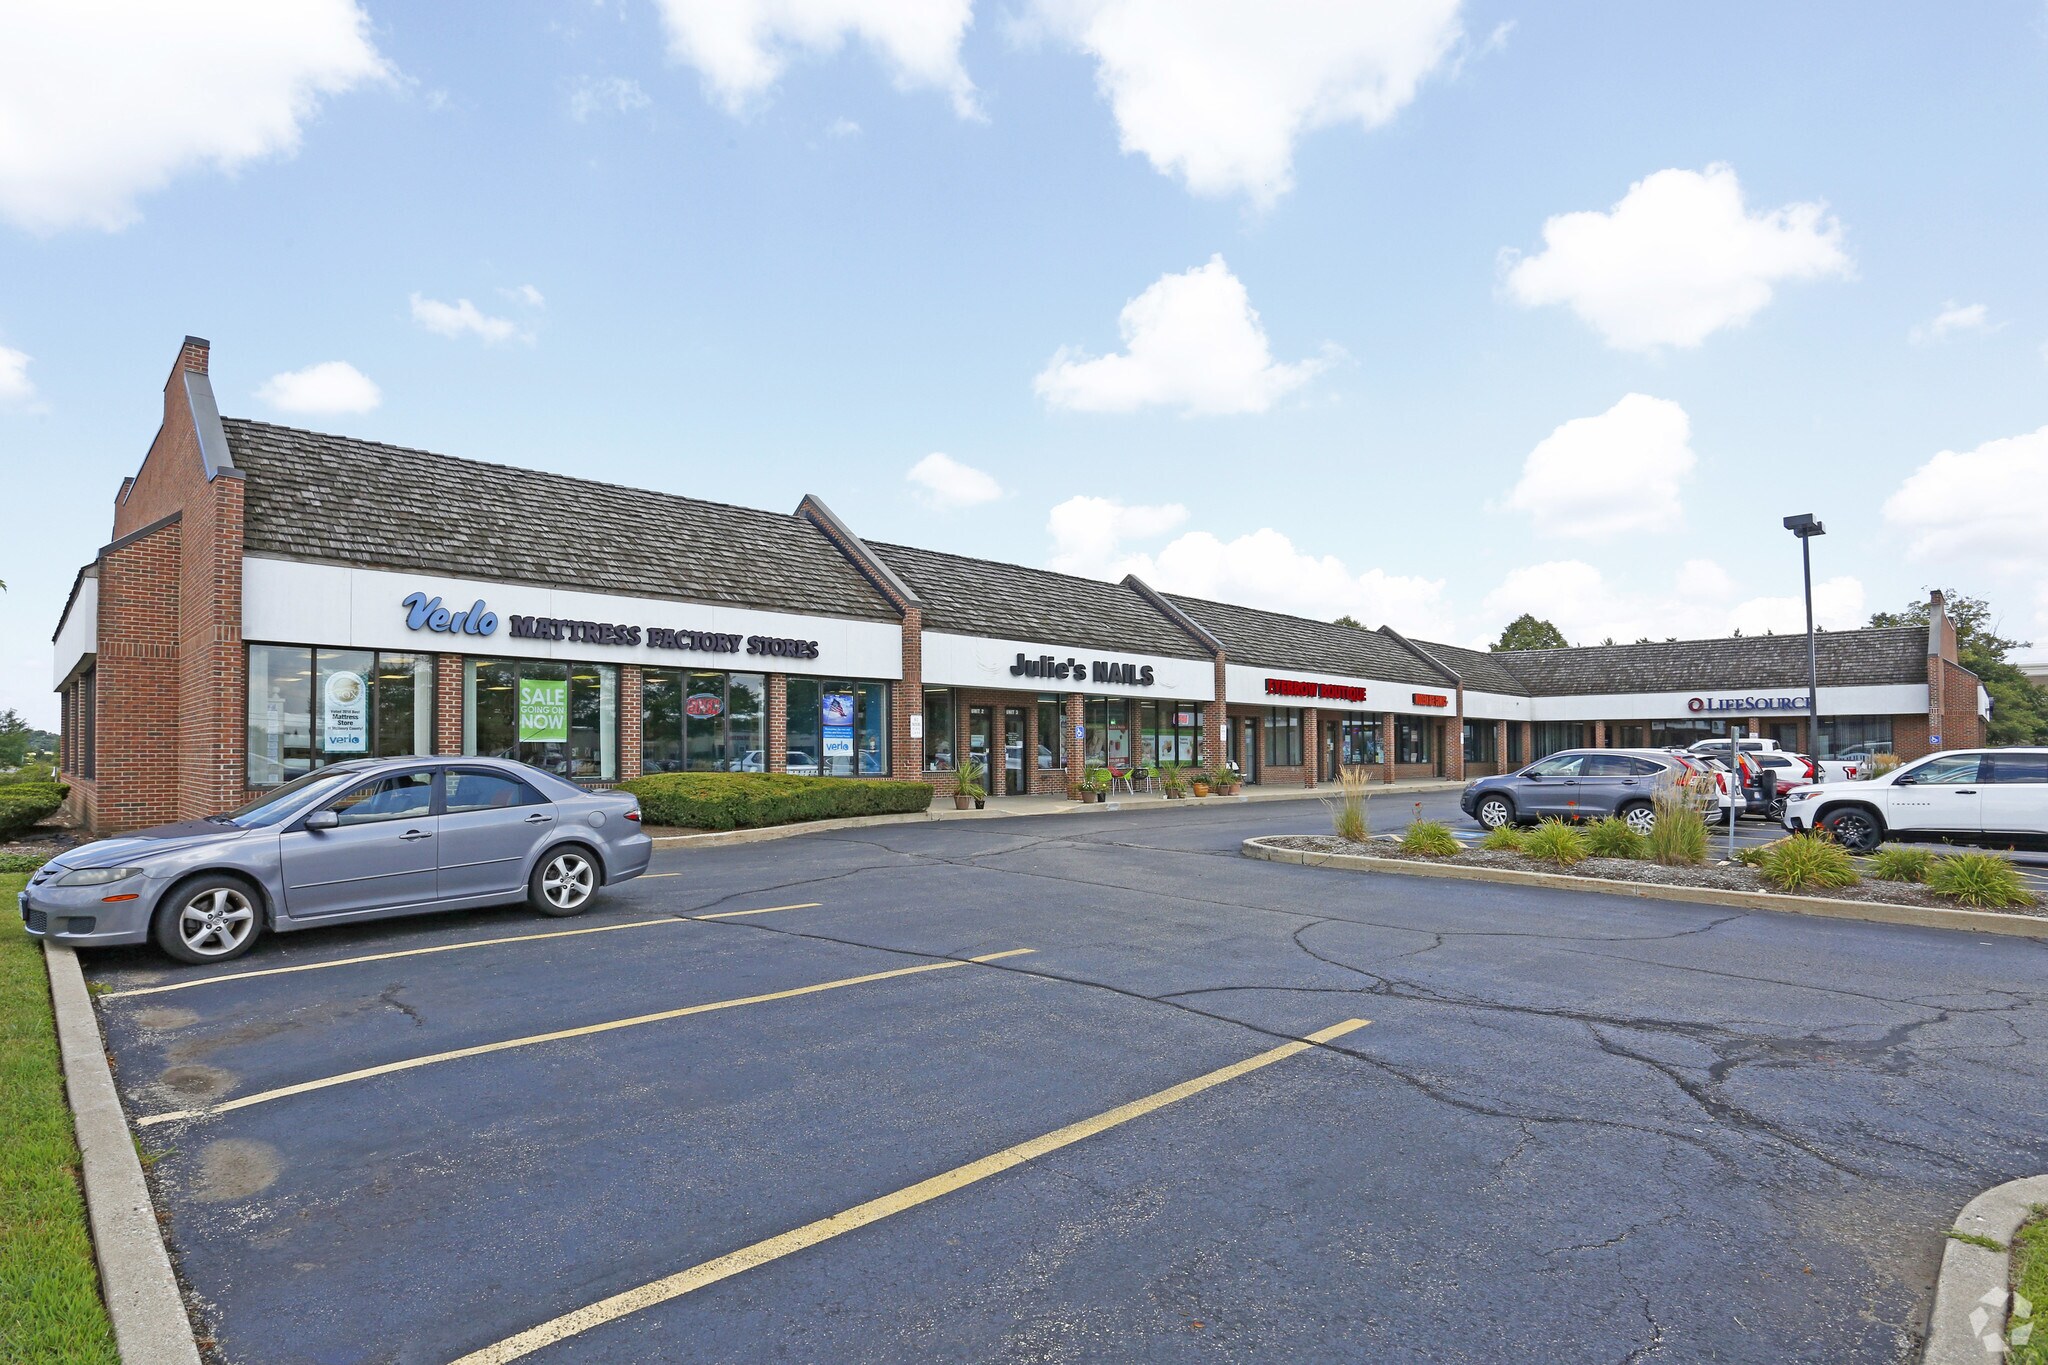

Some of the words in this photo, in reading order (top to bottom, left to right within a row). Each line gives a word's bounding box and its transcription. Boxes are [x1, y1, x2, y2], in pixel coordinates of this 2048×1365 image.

[402, 591, 498, 636] Verlo
[509, 614, 641, 646] MATTRESS
[646, 627, 743, 653] FACTORY
[747, 635, 819, 659] STORES
[1010, 653, 1087, 681] Julie's
[1092, 661, 1155, 686] NAILS
[521, 687, 565, 706] SALE
[1265, 678, 1318, 698] EYEBROW
[1318, 683, 1367, 702] BOUTIQUE
[520, 705, 550, 714] GOING
[551, 706, 565, 715] ON
[521, 714, 564, 730] NOW
[329, 734, 360, 744] verlo
[826, 741, 849, 751] verlo
